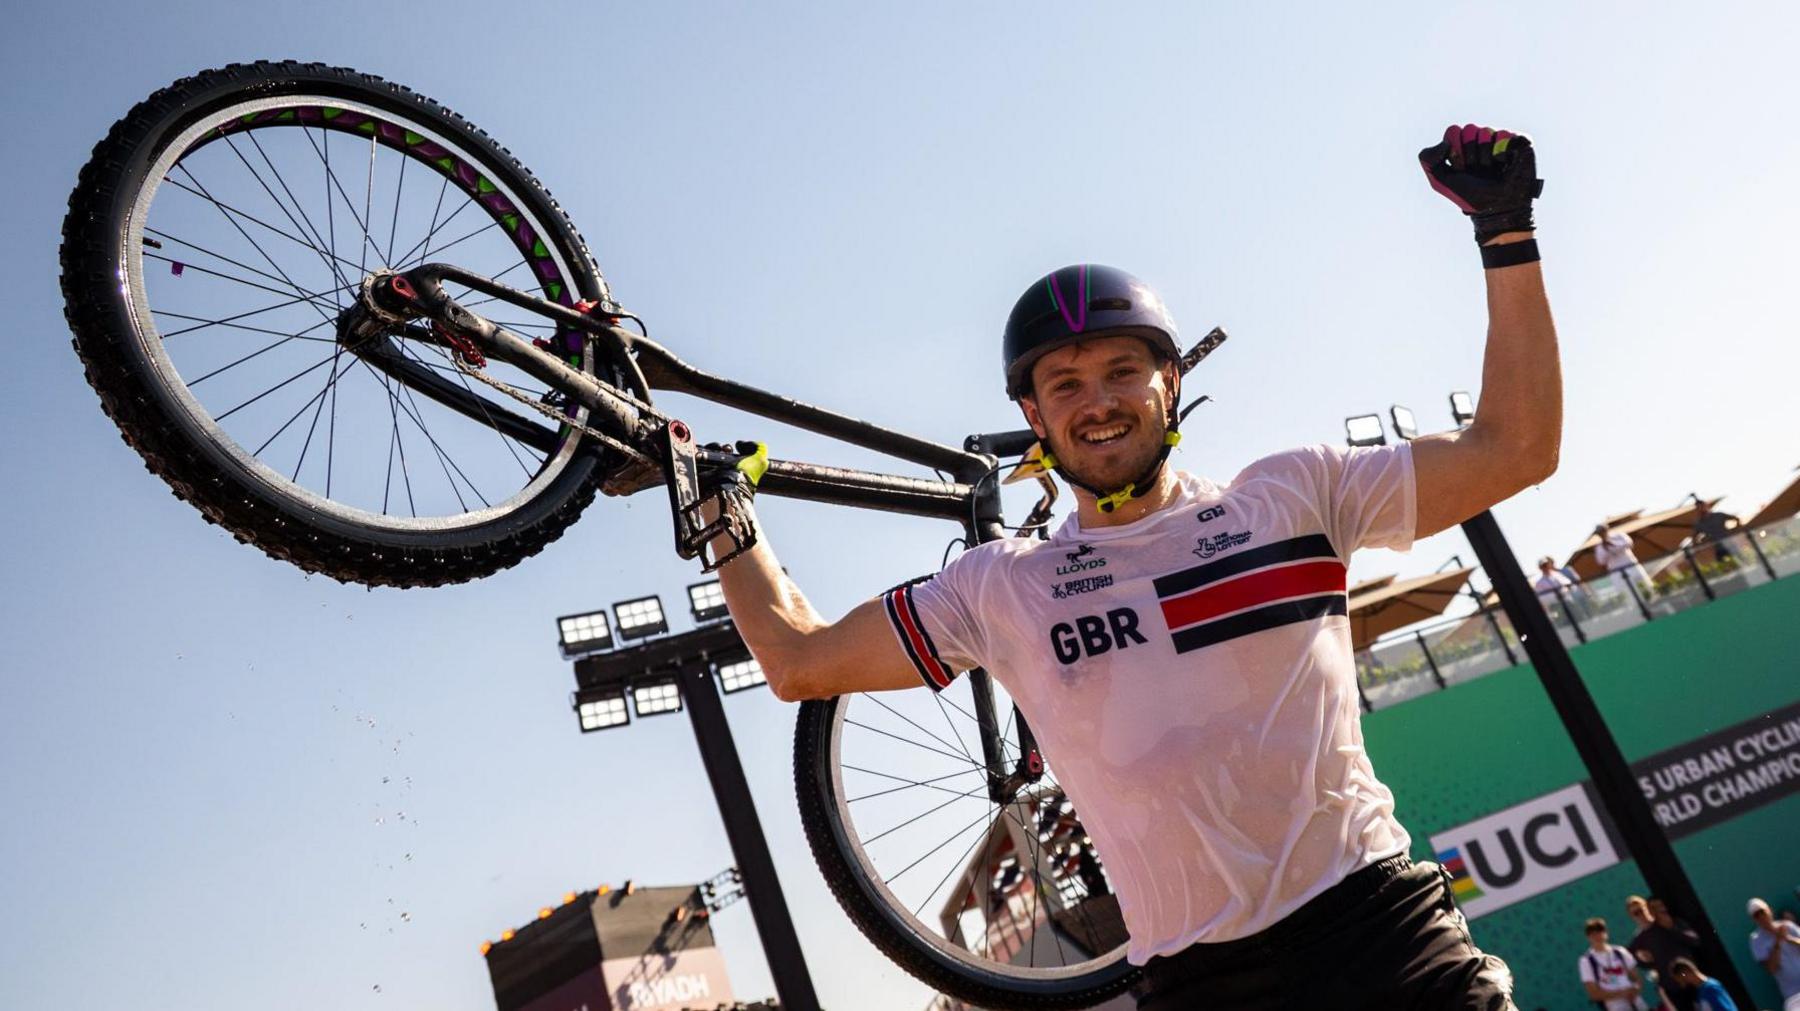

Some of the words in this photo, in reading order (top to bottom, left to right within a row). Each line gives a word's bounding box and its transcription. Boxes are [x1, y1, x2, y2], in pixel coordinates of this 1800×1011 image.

[1056, 557, 1107, 575] LLOYDS
[1065, 574, 1113, 590] BRITISH
[1050, 606, 1148, 666] GBR
[1653, 745, 1736, 792] URBAN
[1652, 793, 1702, 827] RLD
[1465, 803, 1599, 889] UCI
